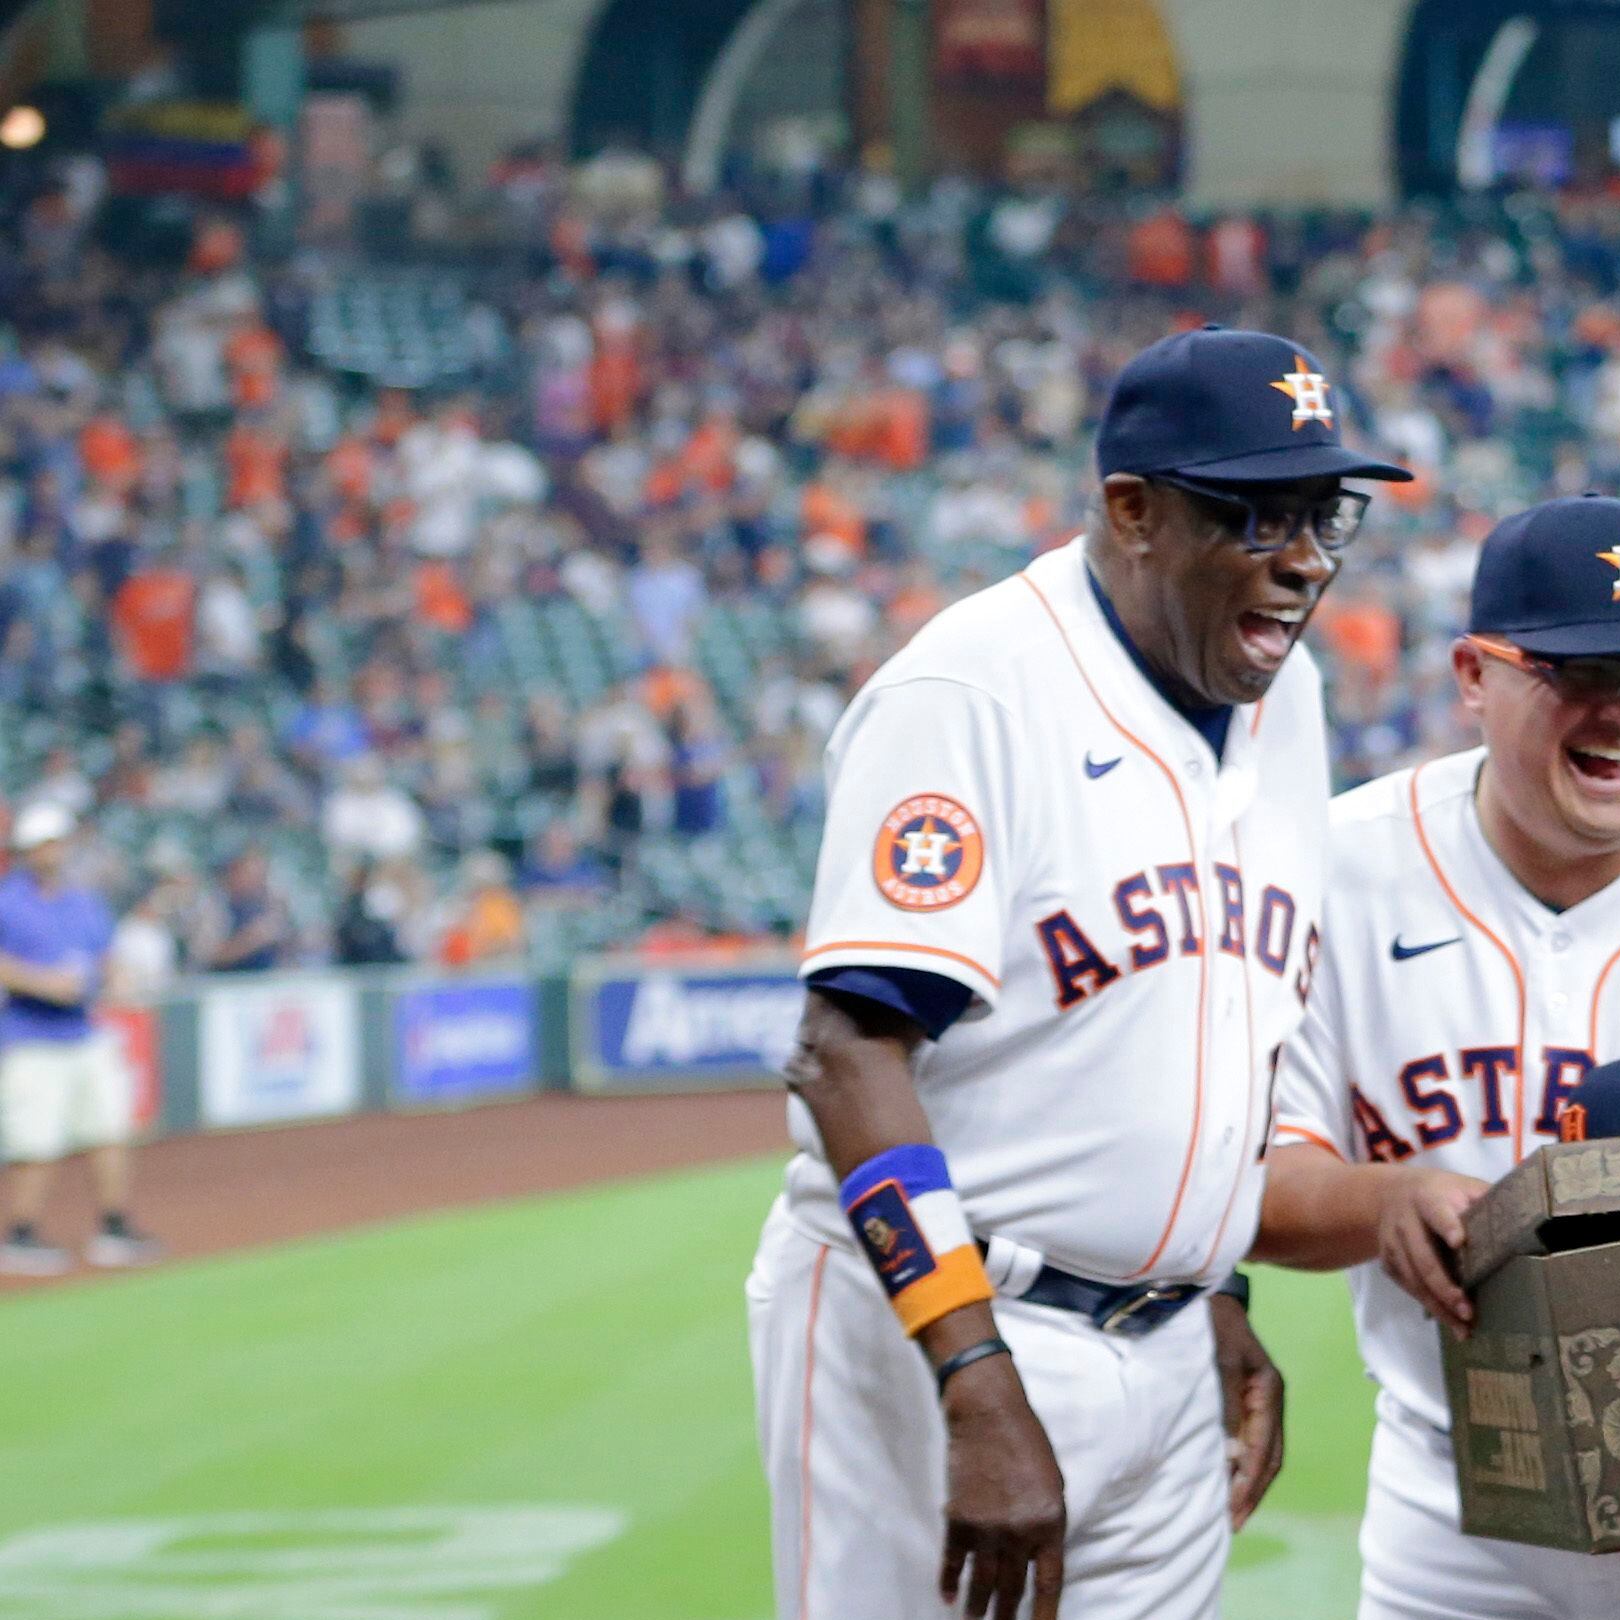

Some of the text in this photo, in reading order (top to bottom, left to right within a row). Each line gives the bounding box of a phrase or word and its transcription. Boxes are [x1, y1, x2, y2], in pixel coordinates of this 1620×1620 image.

[1284, 374, 1333, 420] H
[901, 831, 951, 874] H
[1034, 861, 1321, 1012] ASTROS
[1349, 1045, 1598, 1164] ASTR
